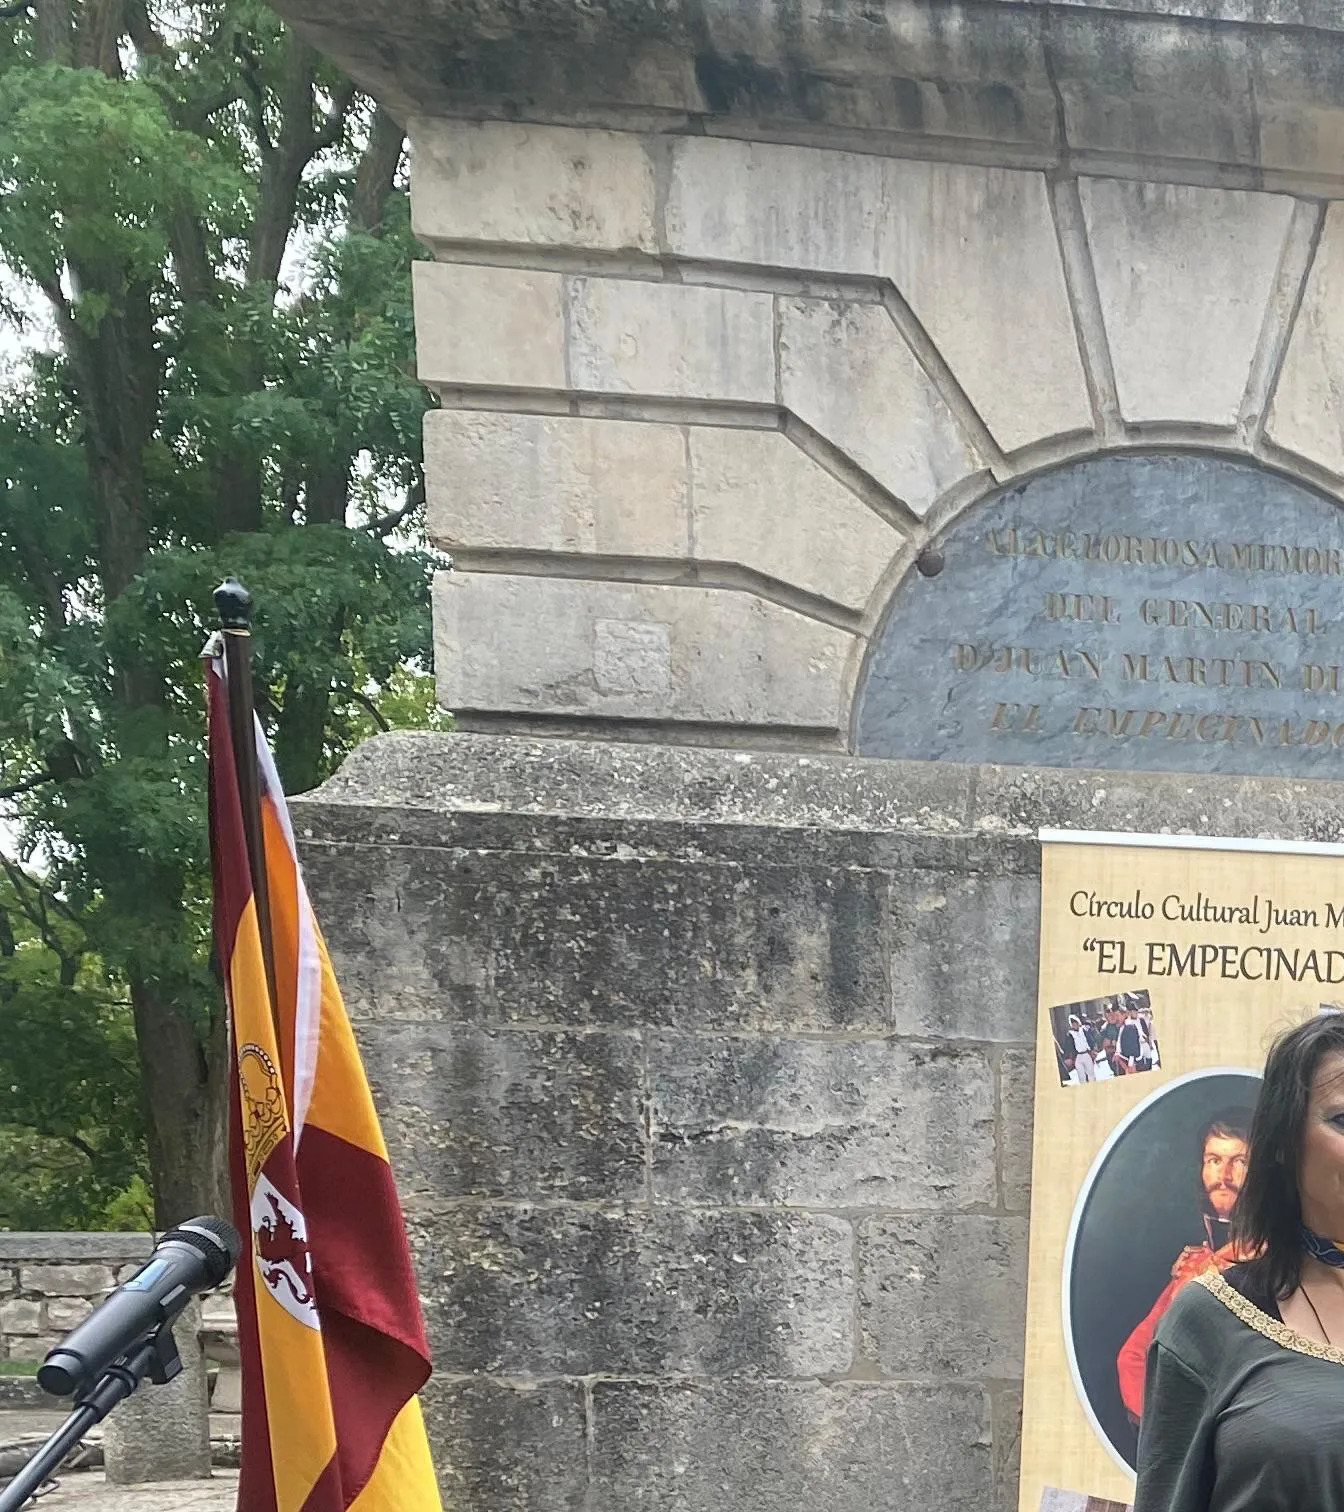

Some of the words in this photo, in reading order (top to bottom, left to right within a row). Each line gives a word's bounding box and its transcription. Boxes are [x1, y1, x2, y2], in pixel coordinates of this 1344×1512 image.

[1043, 591, 1121, 627] DEL
[1138, 597, 1329, 635] GENERAL
[994, 646, 1101, 681] JUAN
[1121, 653, 1283, 690] MARTIN
[990, 702, 1044, 734] EL
[1069, 889, 1155, 920] Círculo
[1161, 891, 1260, 926] Cultural
[1258, 899, 1320, 934] Juan
